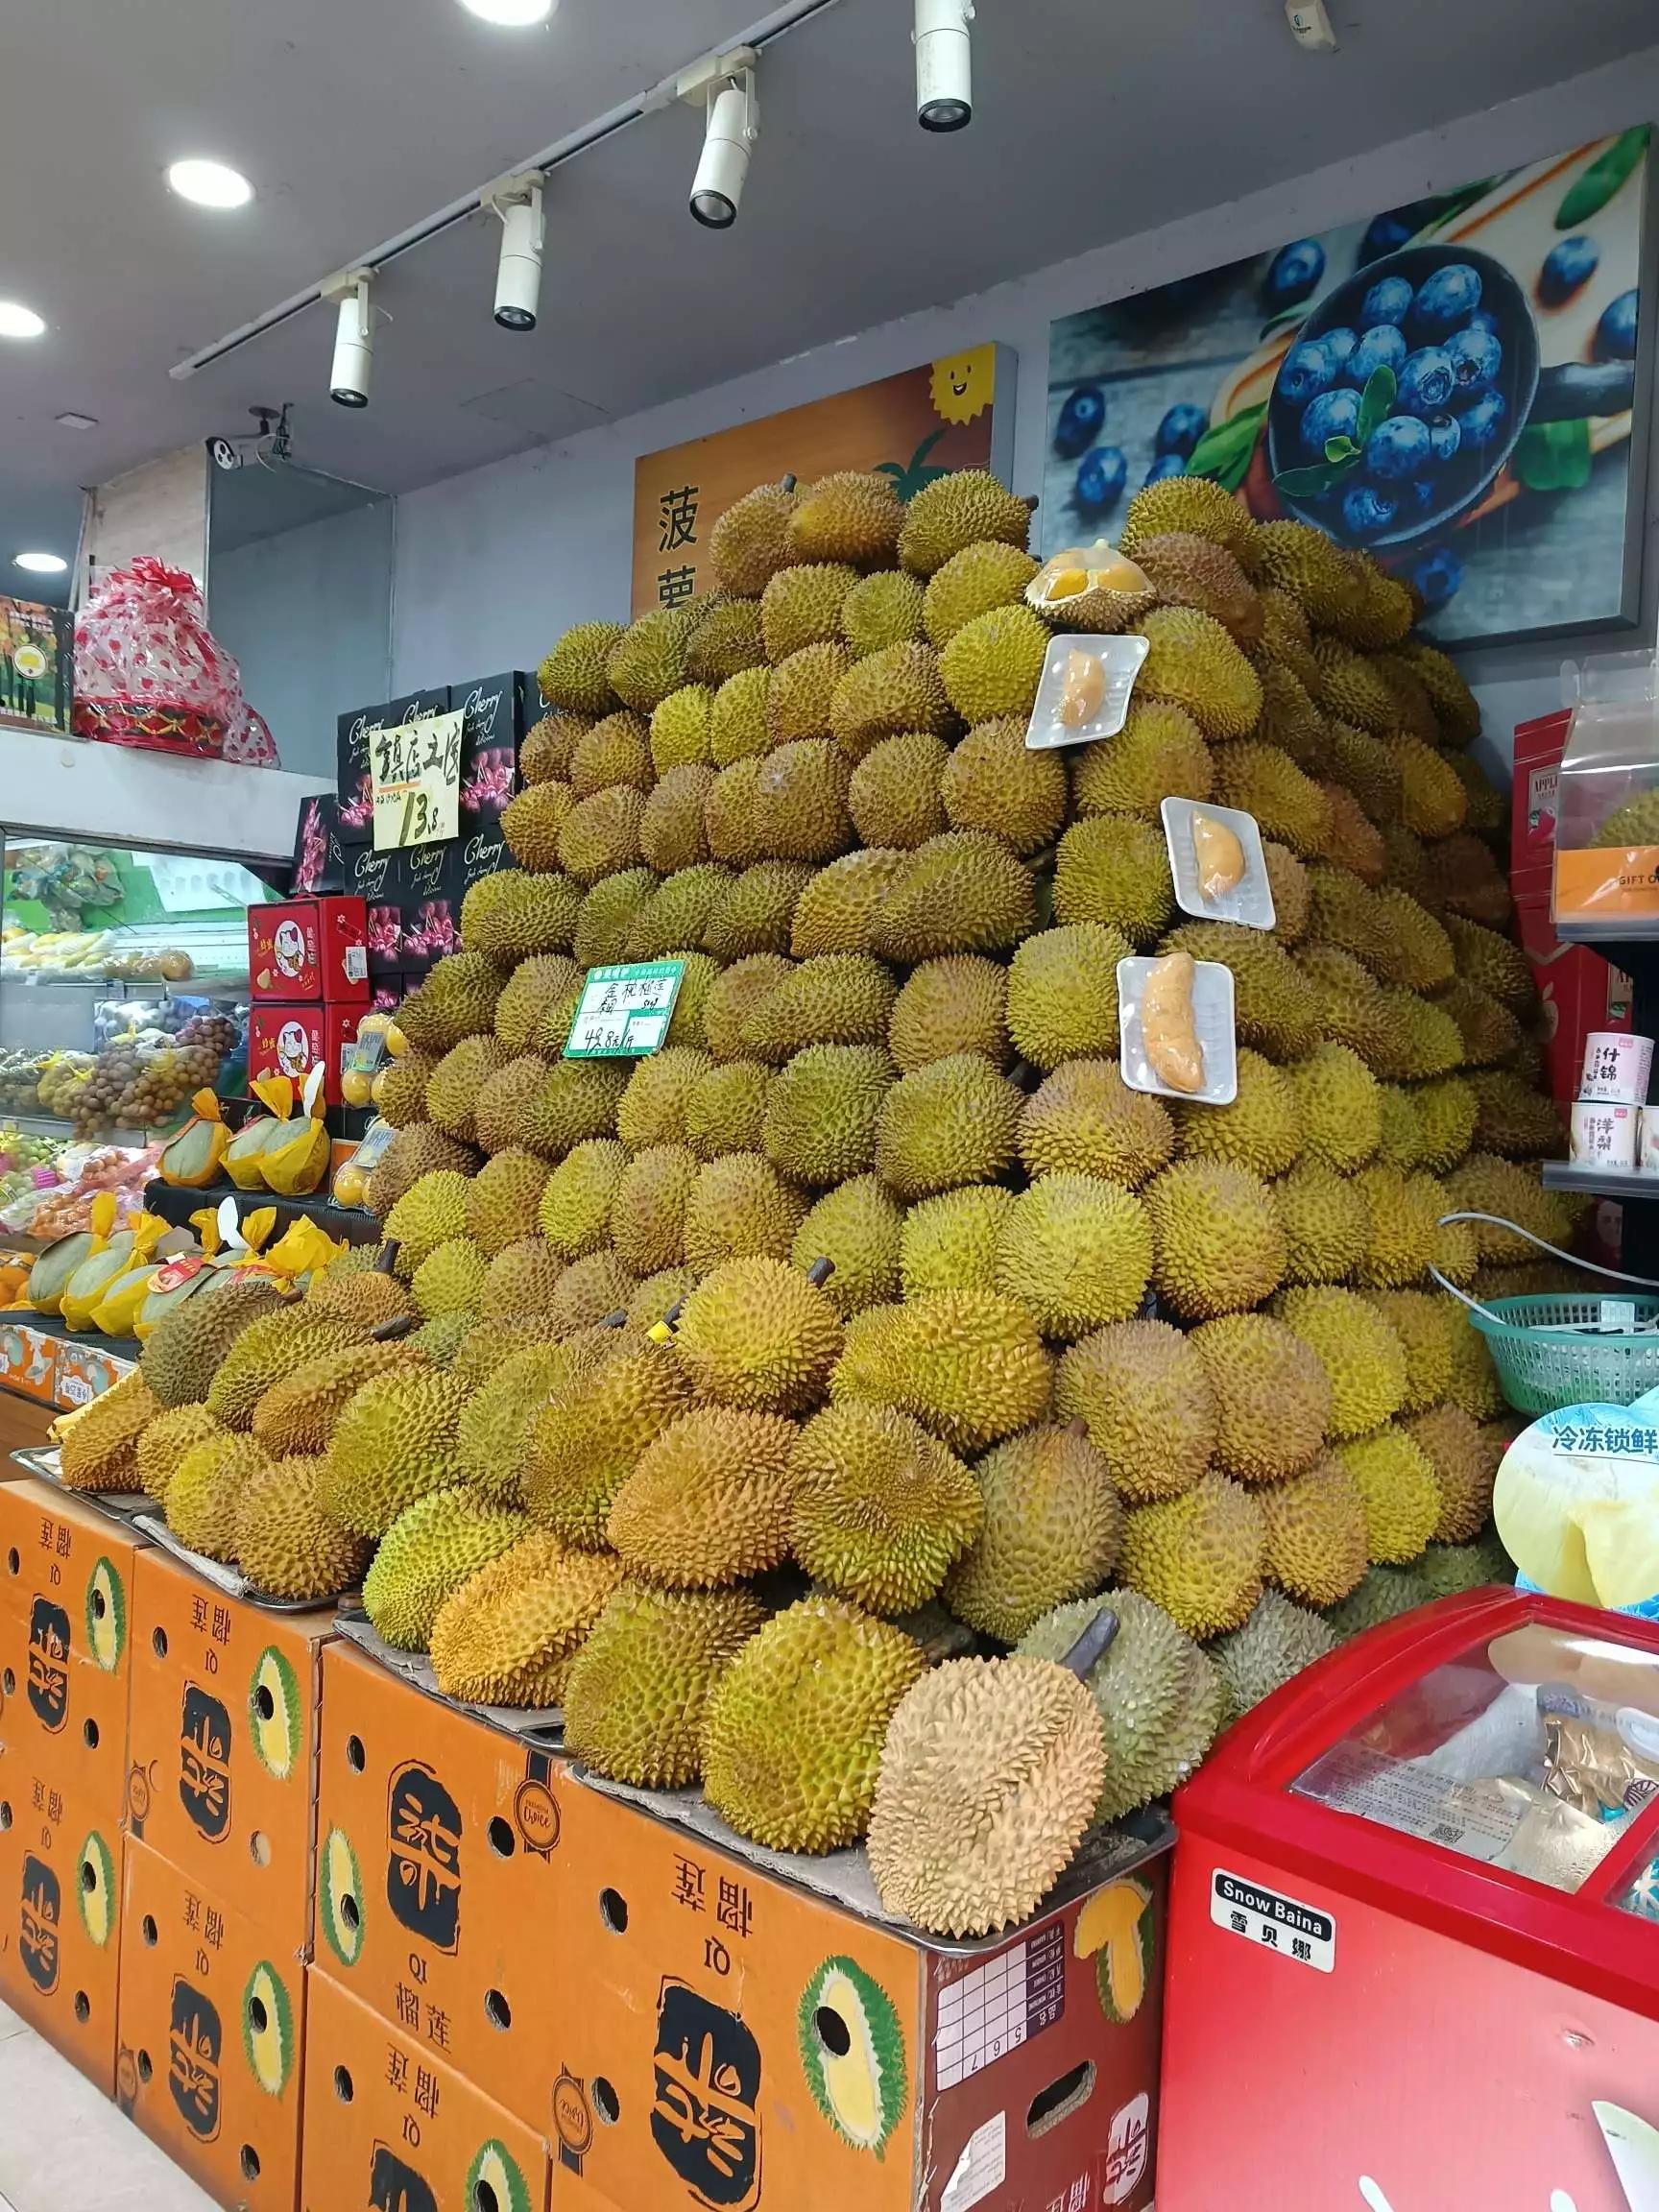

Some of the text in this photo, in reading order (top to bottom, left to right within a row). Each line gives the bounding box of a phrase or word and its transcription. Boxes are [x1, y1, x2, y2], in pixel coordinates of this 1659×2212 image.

[464, 686, 503, 733] Cherry
[355, 850, 392, 892] Cherry
[410, 844, 447, 884] Cherry
[464, 833, 506, 876] Cherry
[1620, 875, 1645, 884] GIFT
[1599, 1046, 1621, 1082] 什锦
[1552, 1425, 1659, 1454] 冷冻锁鲜
[39, 1517, 72, 1559] 榴莲
[50, 1563, 61, 1585] QI
[190, 1595, 230, 1646] 榴莲
[205, 1647, 218, 1674] QI
[32, 1776, 63, 1826] 榴莲
[524, 1804, 551, 1828] Choice
[40, 1825, 52, 1850] QI
[671, 1853, 754, 1938] 榴莲
[1223, 1881, 1322, 1936] Snow Baina
[183, 1890, 223, 1950] 榴莲
[1230, 1911, 1311, 1961] 雪贝娜
[197, 1948, 210, 1976] QI
[409, 1953, 427, 1984] QI
[704, 1936, 731, 1976] QI
[396, 1982, 452, 2055] 榴莲
[1015, 2027, 1022, 2043] 5
[972, 2054, 978, 2071] 7
[993, 2040, 1000, 2056] 6
[386, 2043, 439, 2118] 榴莲
[402, 2114, 421, 2148] QI
